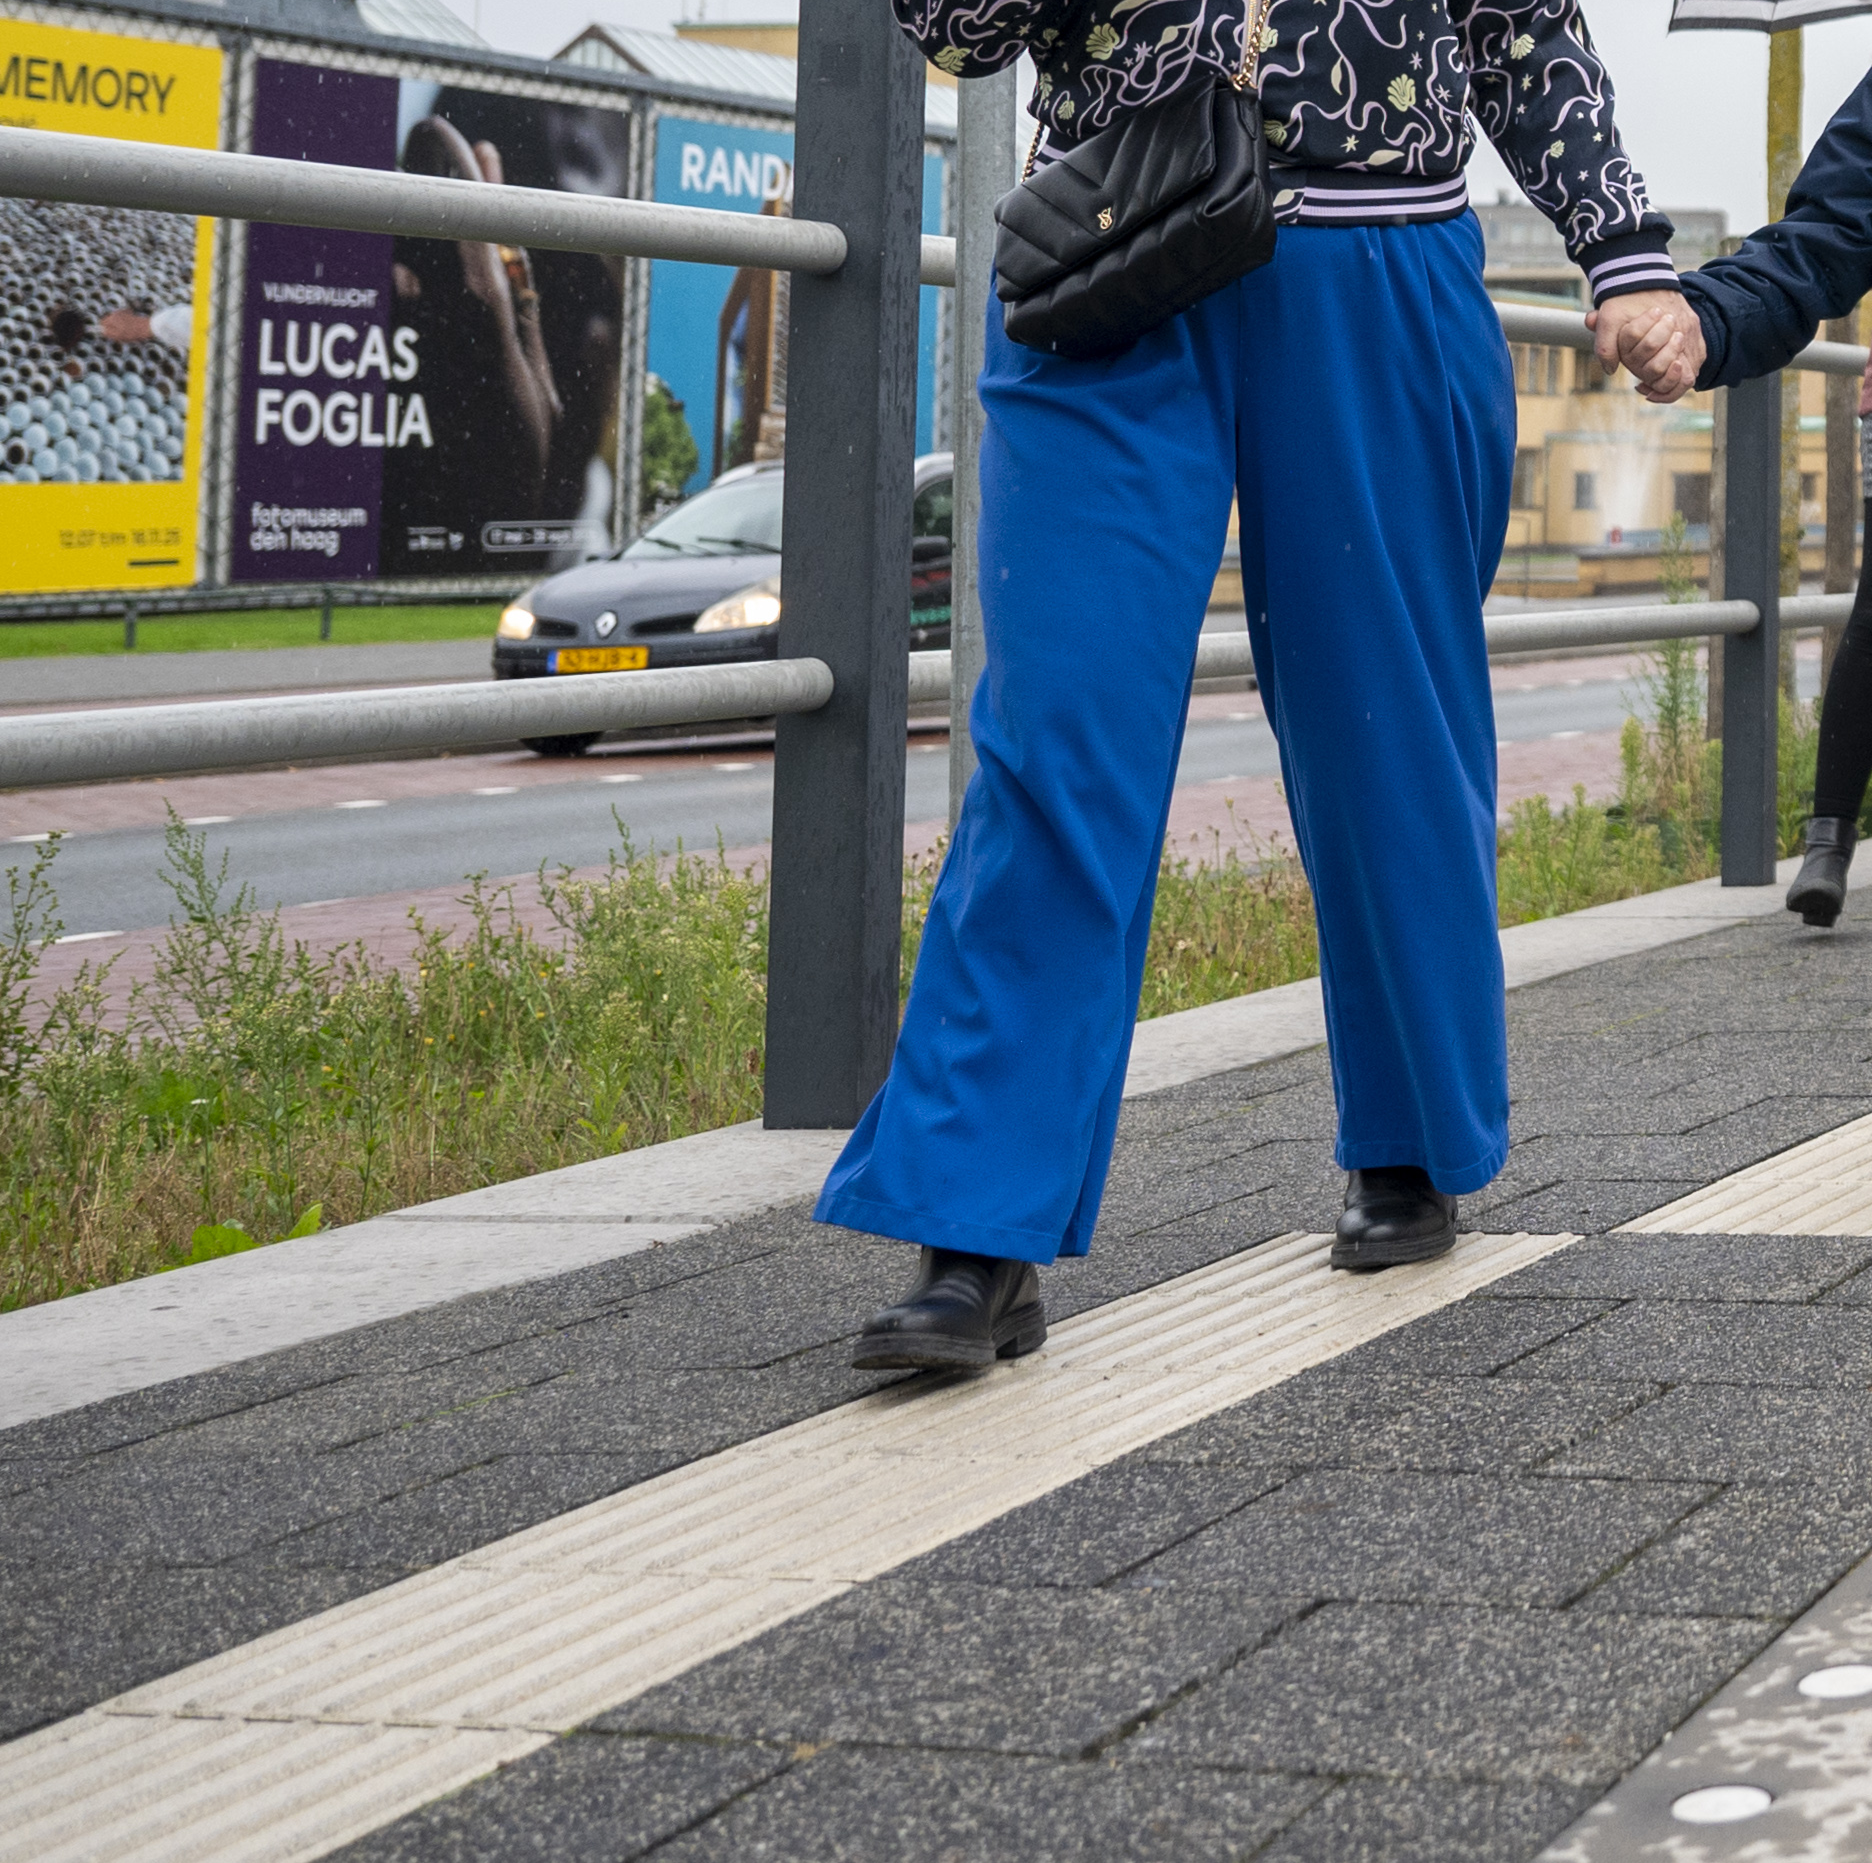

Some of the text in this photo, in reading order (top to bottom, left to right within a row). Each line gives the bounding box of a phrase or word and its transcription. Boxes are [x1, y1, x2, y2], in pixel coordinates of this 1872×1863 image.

[0, 53, 176, 115] MEMORY
[681, 141, 794, 205] RAND
[259, 318, 420, 381] LUCAS
[255, 388, 434, 448] FOGLIA
[250, 523, 341, 558] den haag
[251, 501, 368, 530] fotomuseum
